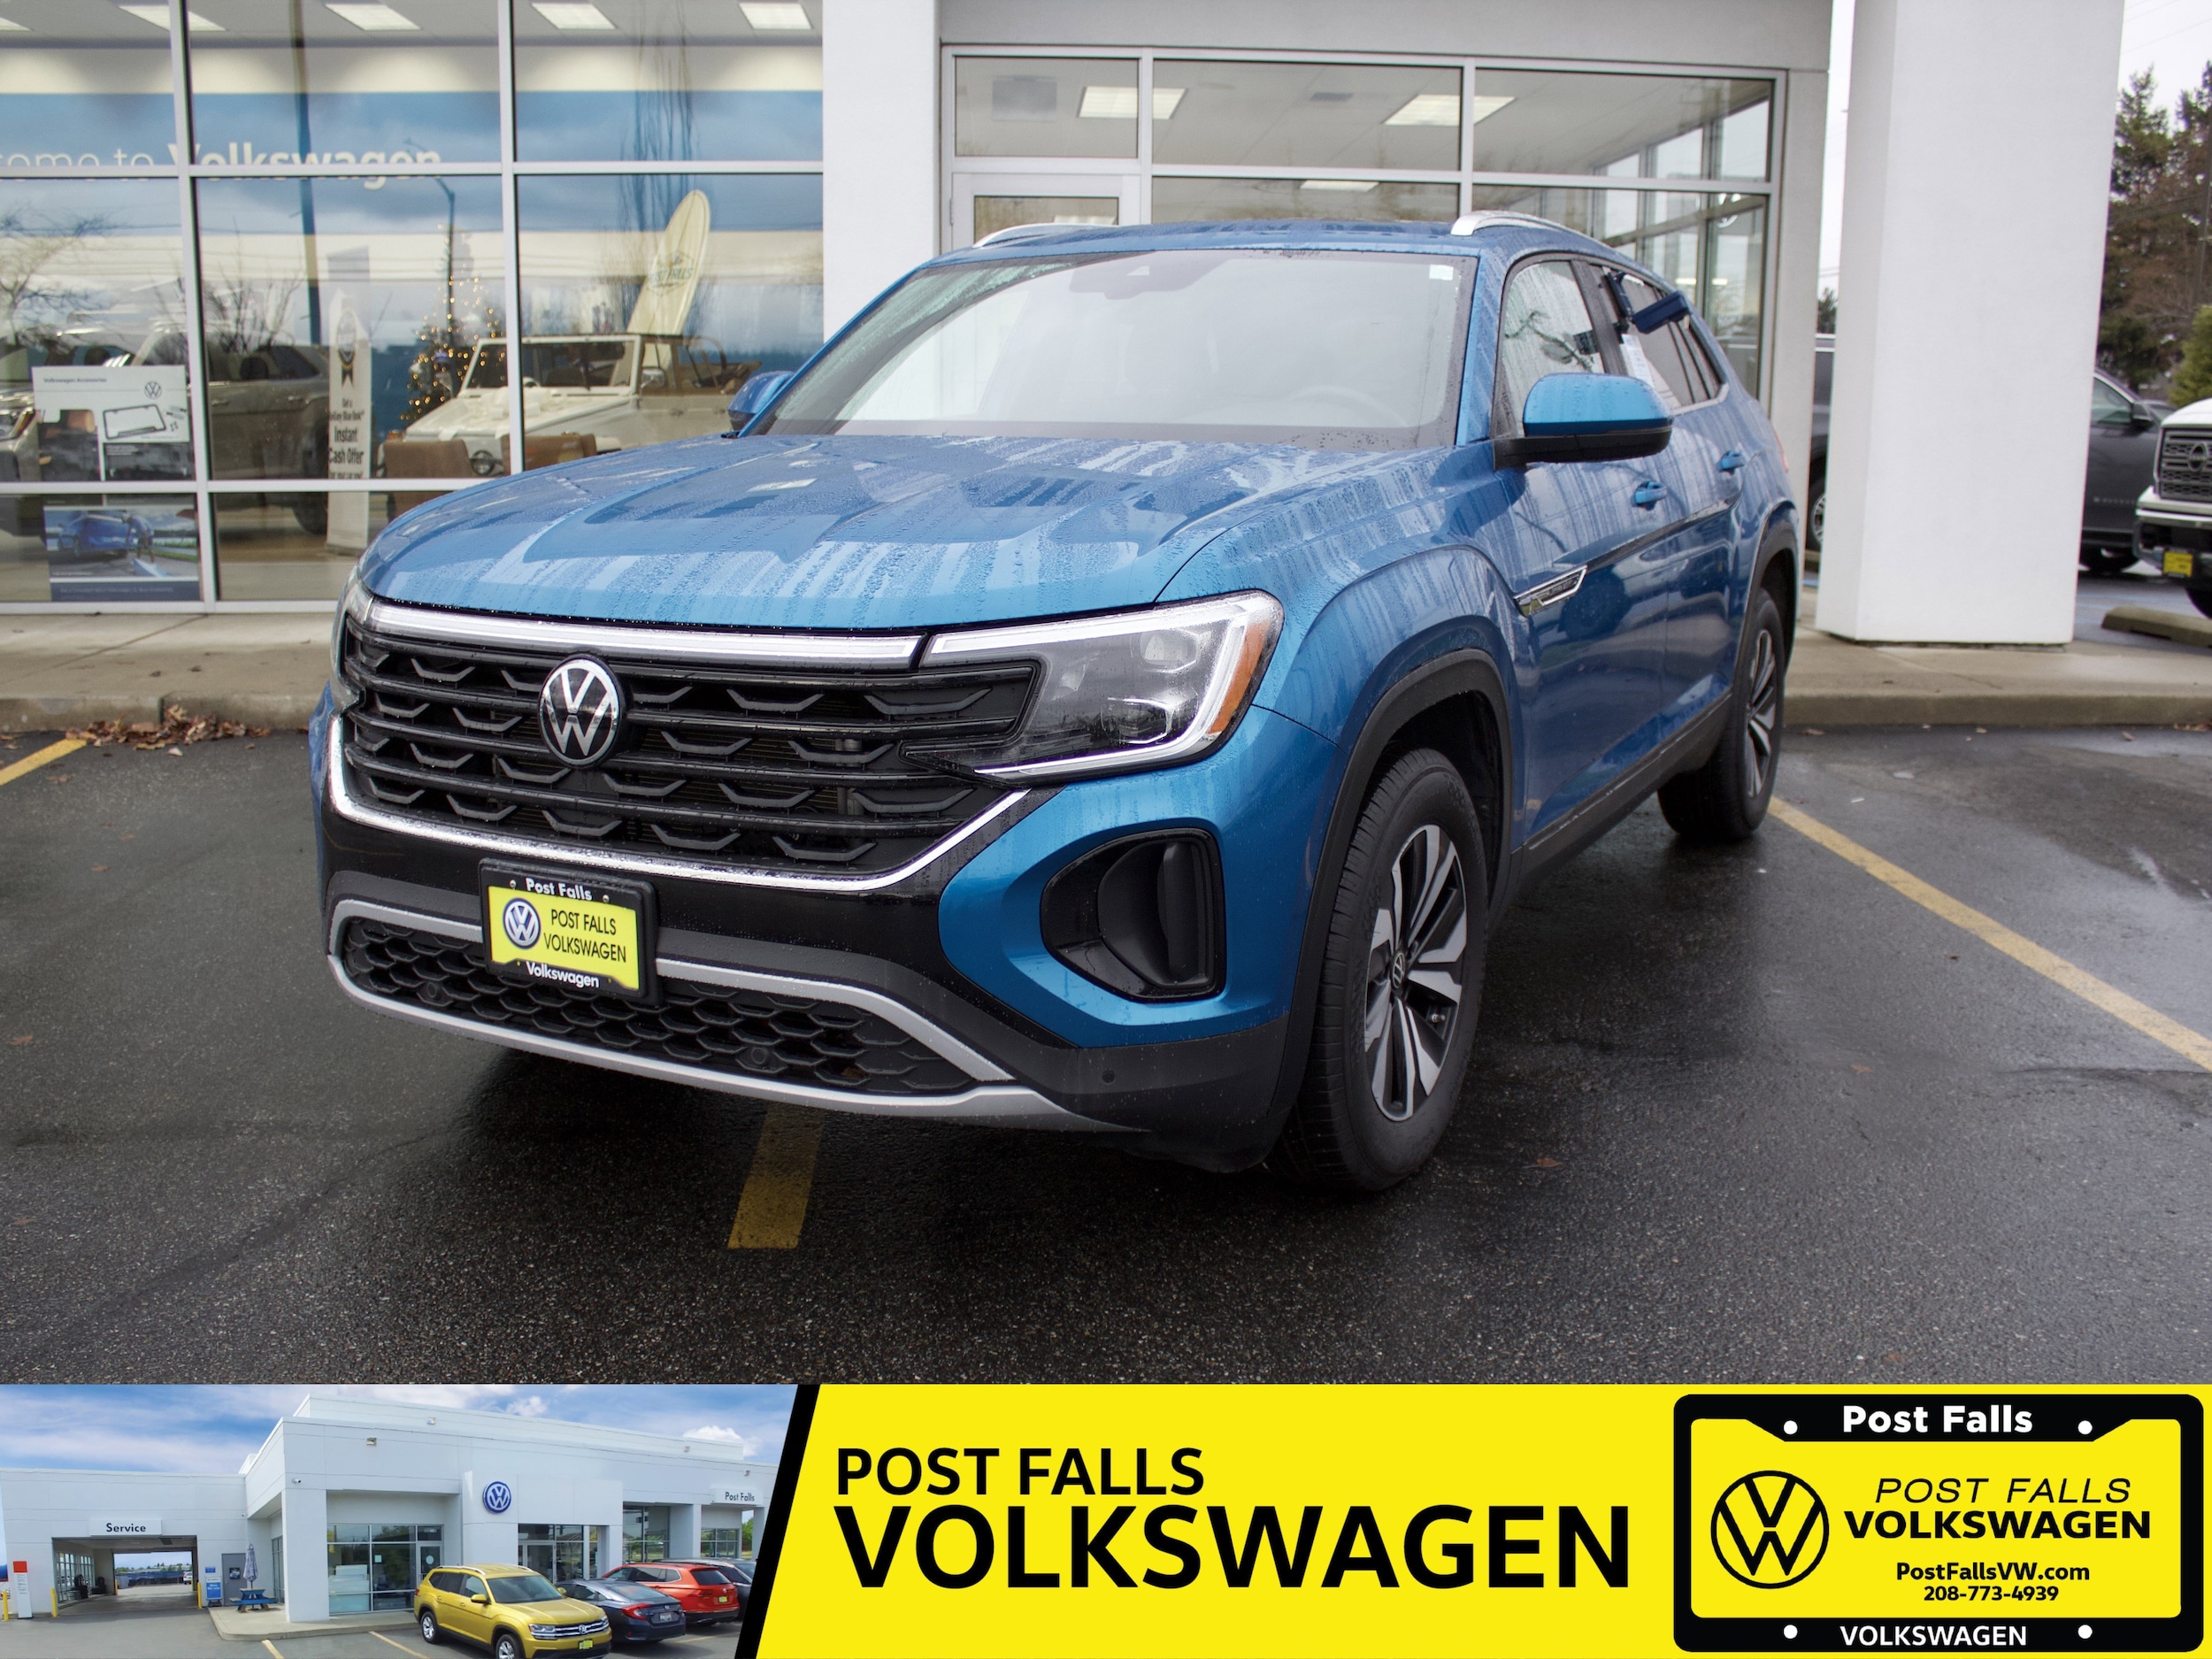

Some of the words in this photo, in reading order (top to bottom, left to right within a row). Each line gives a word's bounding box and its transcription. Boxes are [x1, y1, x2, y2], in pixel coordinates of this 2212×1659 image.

[334, 426, 357, 442] Instant
[347, 448, 364, 465] Offer
[525, 878, 555, 895] Post
[558, 882, 593, 901] Falls
[551, 909, 580, 930] POST
[584, 914, 617, 935] FALLS
[543, 933, 626, 963] VOLKSWAGEN
[526, 961, 599, 987] Volkswagen
